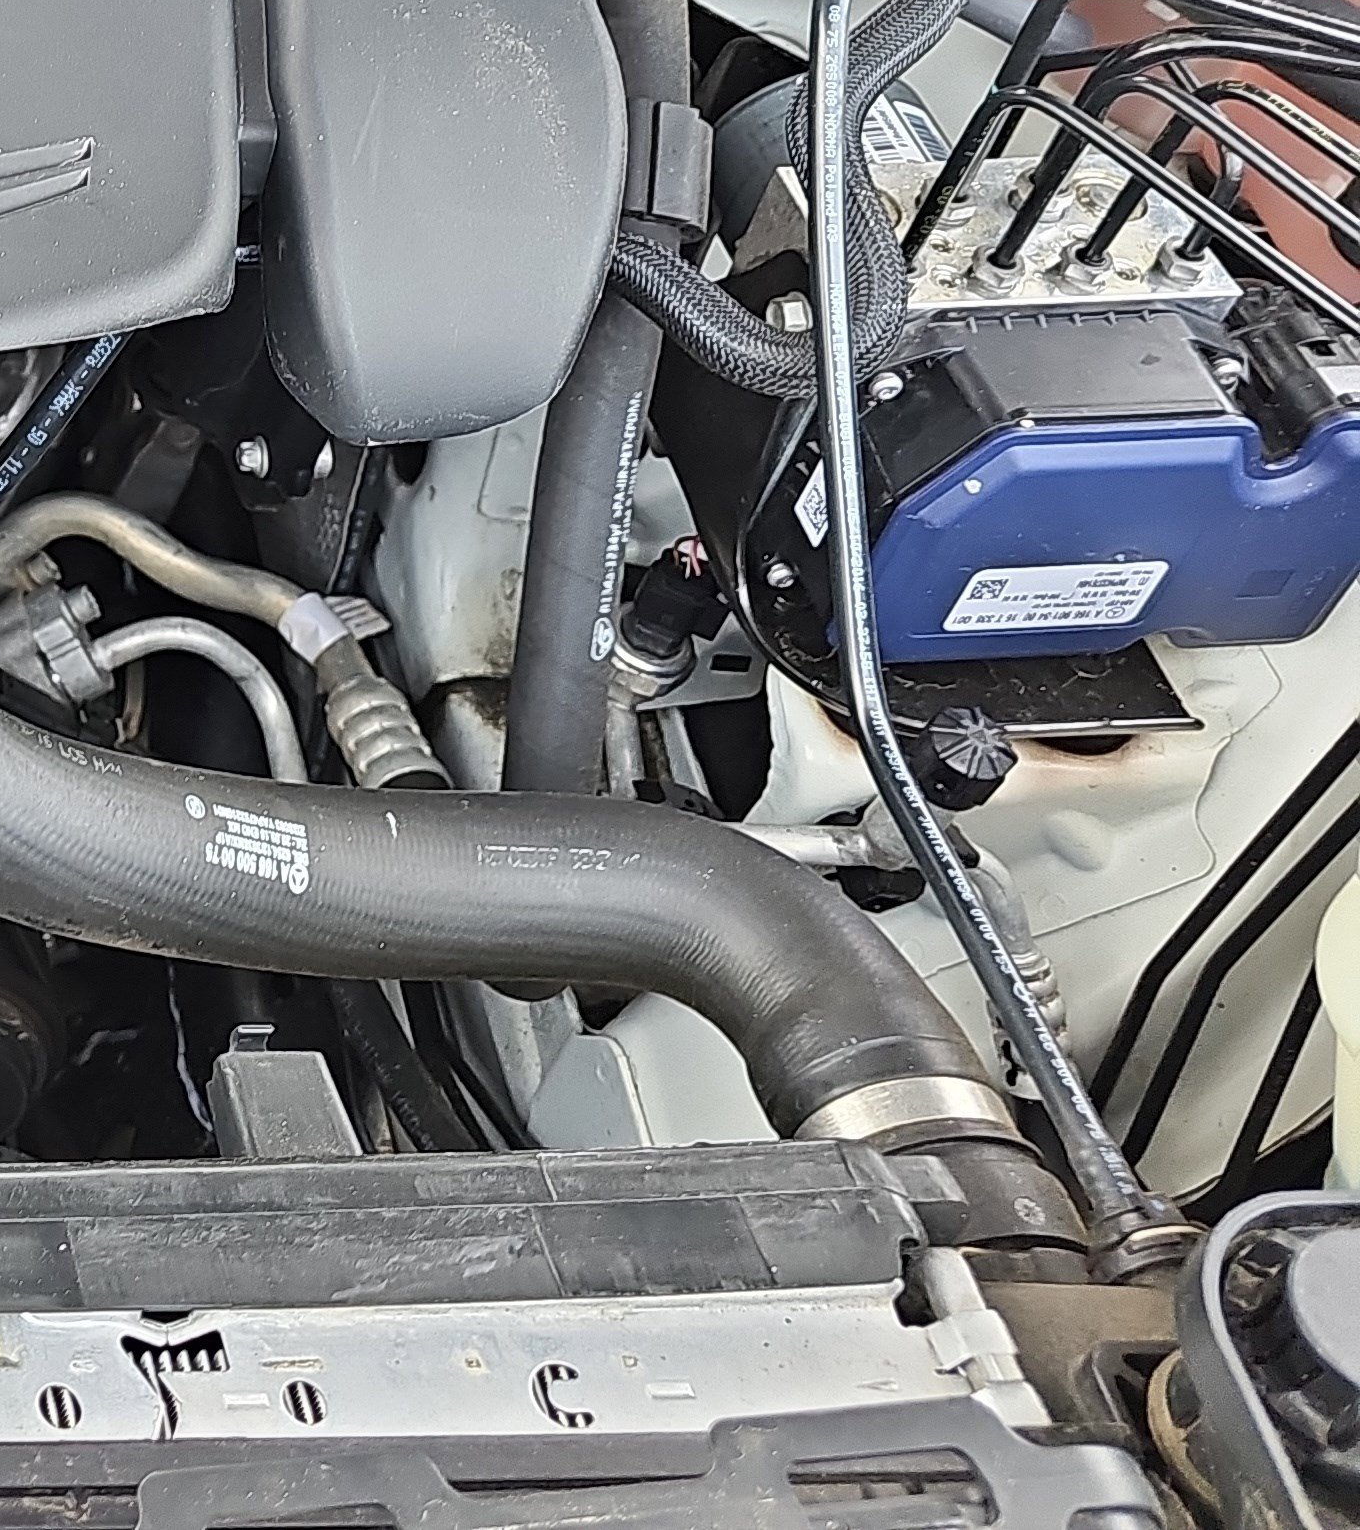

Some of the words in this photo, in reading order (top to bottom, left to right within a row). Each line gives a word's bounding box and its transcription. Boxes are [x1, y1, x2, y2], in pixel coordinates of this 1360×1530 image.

[828, 6, 841, 23] 08
[826, 28, 840, 49] 75
[824, 113, 838, 159] NORMA
[824, 165, 839, 222] Poland
[1093, 608, 1104, 619] A
[221, 846, 236, 870] 00
[236, 849, 257, 875] 500
[280, 860, 291, 884] A
